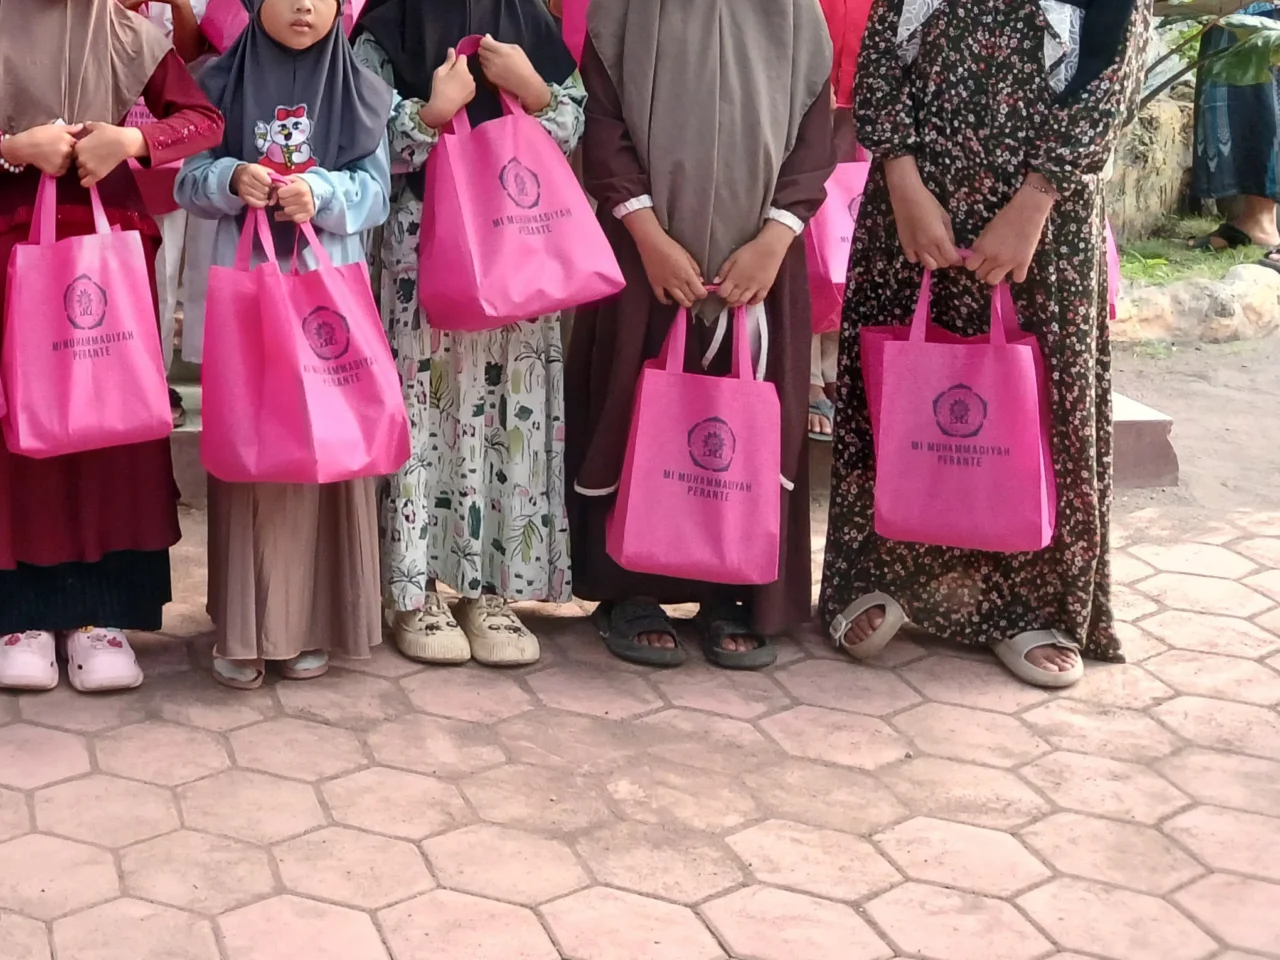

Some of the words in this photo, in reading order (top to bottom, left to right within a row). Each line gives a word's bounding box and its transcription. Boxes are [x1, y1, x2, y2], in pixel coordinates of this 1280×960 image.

[492, 217, 504, 228] MI
[52, 341, 62, 351] MI
[63, 330, 134, 349] MUHAMMADIYAH
[73, 346, 111, 360] PERANTE
[911, 441, 923, 450] MI
[927, 442, 1010, 456] MUHAMMADIYAH
[937, 455, 982, 467] PERANTE
[663, 469, 675, 480] MI
[678, 472, 752, 492] MUHAMMADIYAH
[687, 486, 730, 502] PERANTE
